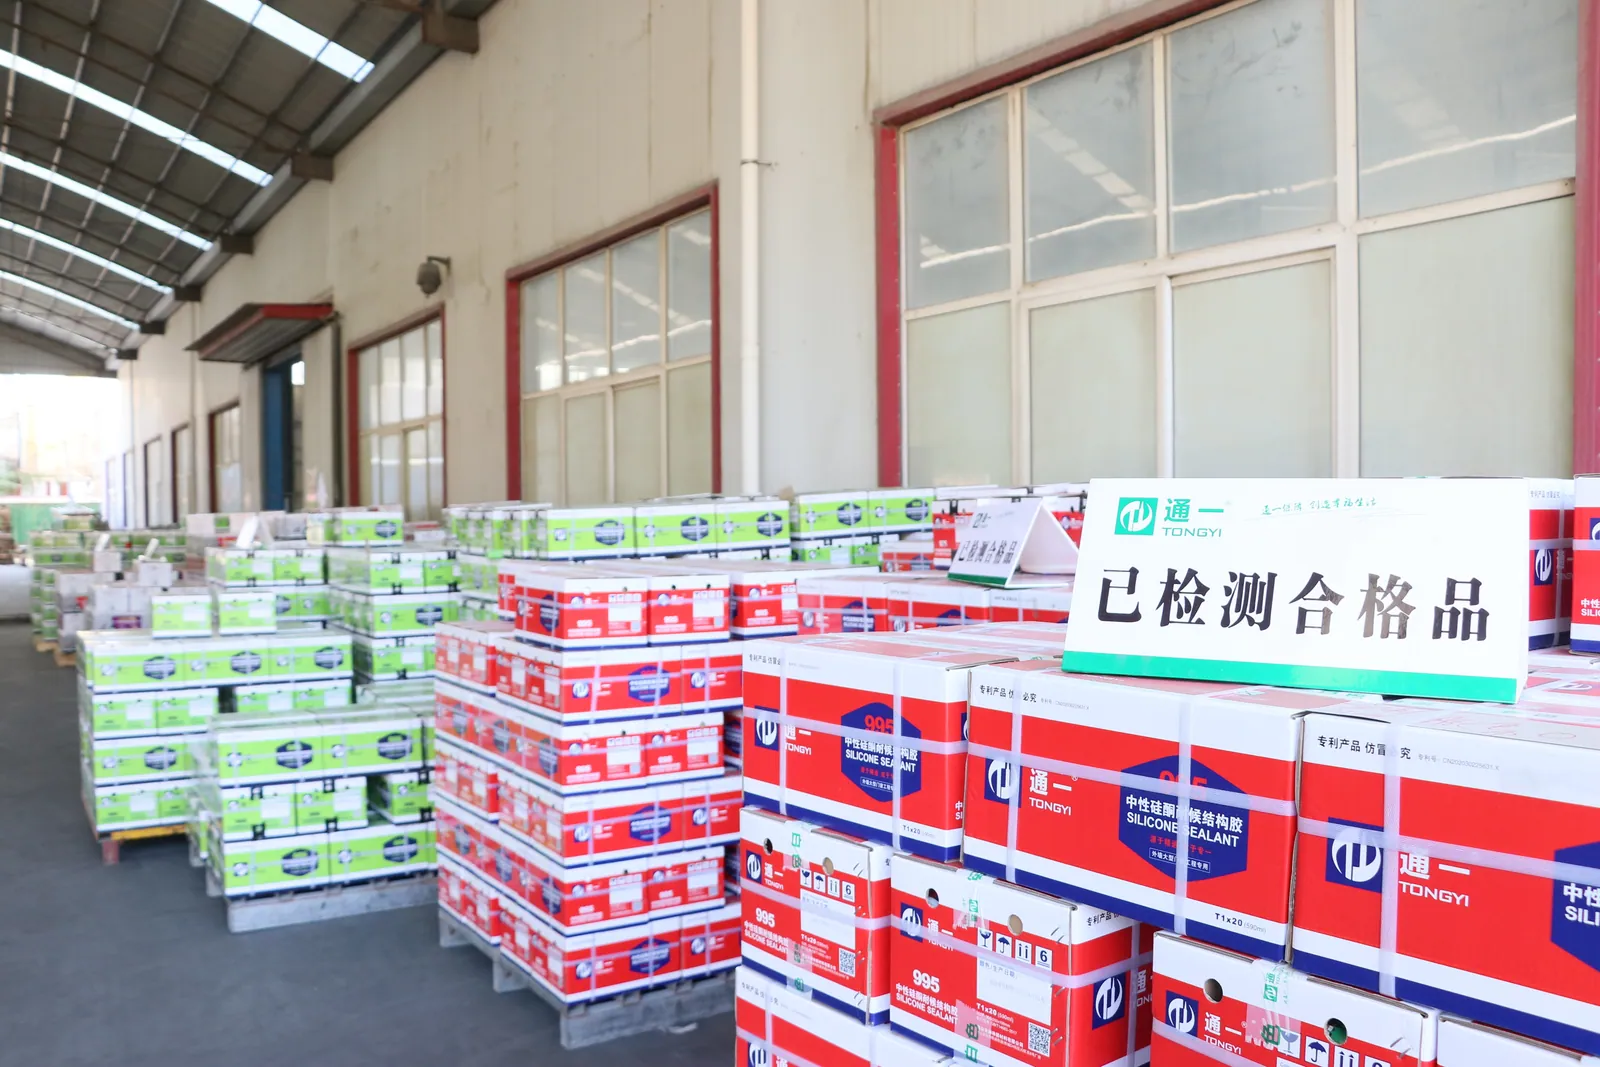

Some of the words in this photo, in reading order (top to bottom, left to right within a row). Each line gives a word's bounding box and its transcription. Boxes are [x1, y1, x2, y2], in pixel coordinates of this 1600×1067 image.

[1164, 498, 1224, 523] 通一
[1162, 526, 1222, 538] TONGYI
[1098, 566, 1489, 641] 已检测合格品
[980, 685, 1006, 697] 专利产品
[1008, 689, 1037, 703] 仿必究
[1317, 735, 1361, 752] 专利产品
[1364, 742, 1411, 760] 仿冒究
[845, 748, 879, 765] SILICONE
[880, 756, 916, 773] SEAANT
[1030, 768, 1072, 796] 通一
[1029, 797, 1072, 816] TONGYI
[1126, 811, 1179, 834] SILICONE
[1181, 824, 1240, 848] SEALANT
[1400, 850, 1471, 880] 通一
[1398, 880, 1470, 908] TONGYI
[1563, 882, 1600, 908] 中性
[756, 907, 775, 928] 995
[1087, 911, 1112, 926] 专利产品
[1214, 912, 1243, 927] T1x20
[1040, 950, 1048, 962] 6
[912, 969, 940, 993] 995
[896, 992, 927, 1012] SILICONE
[926, 1005, 958, 1025] SEALANT
[976, 1003, 998, 1017] T1x20
[1204, 1012, 1242, 1036] 通一
[1204, 1034, 1242, 1055] TONGYI
